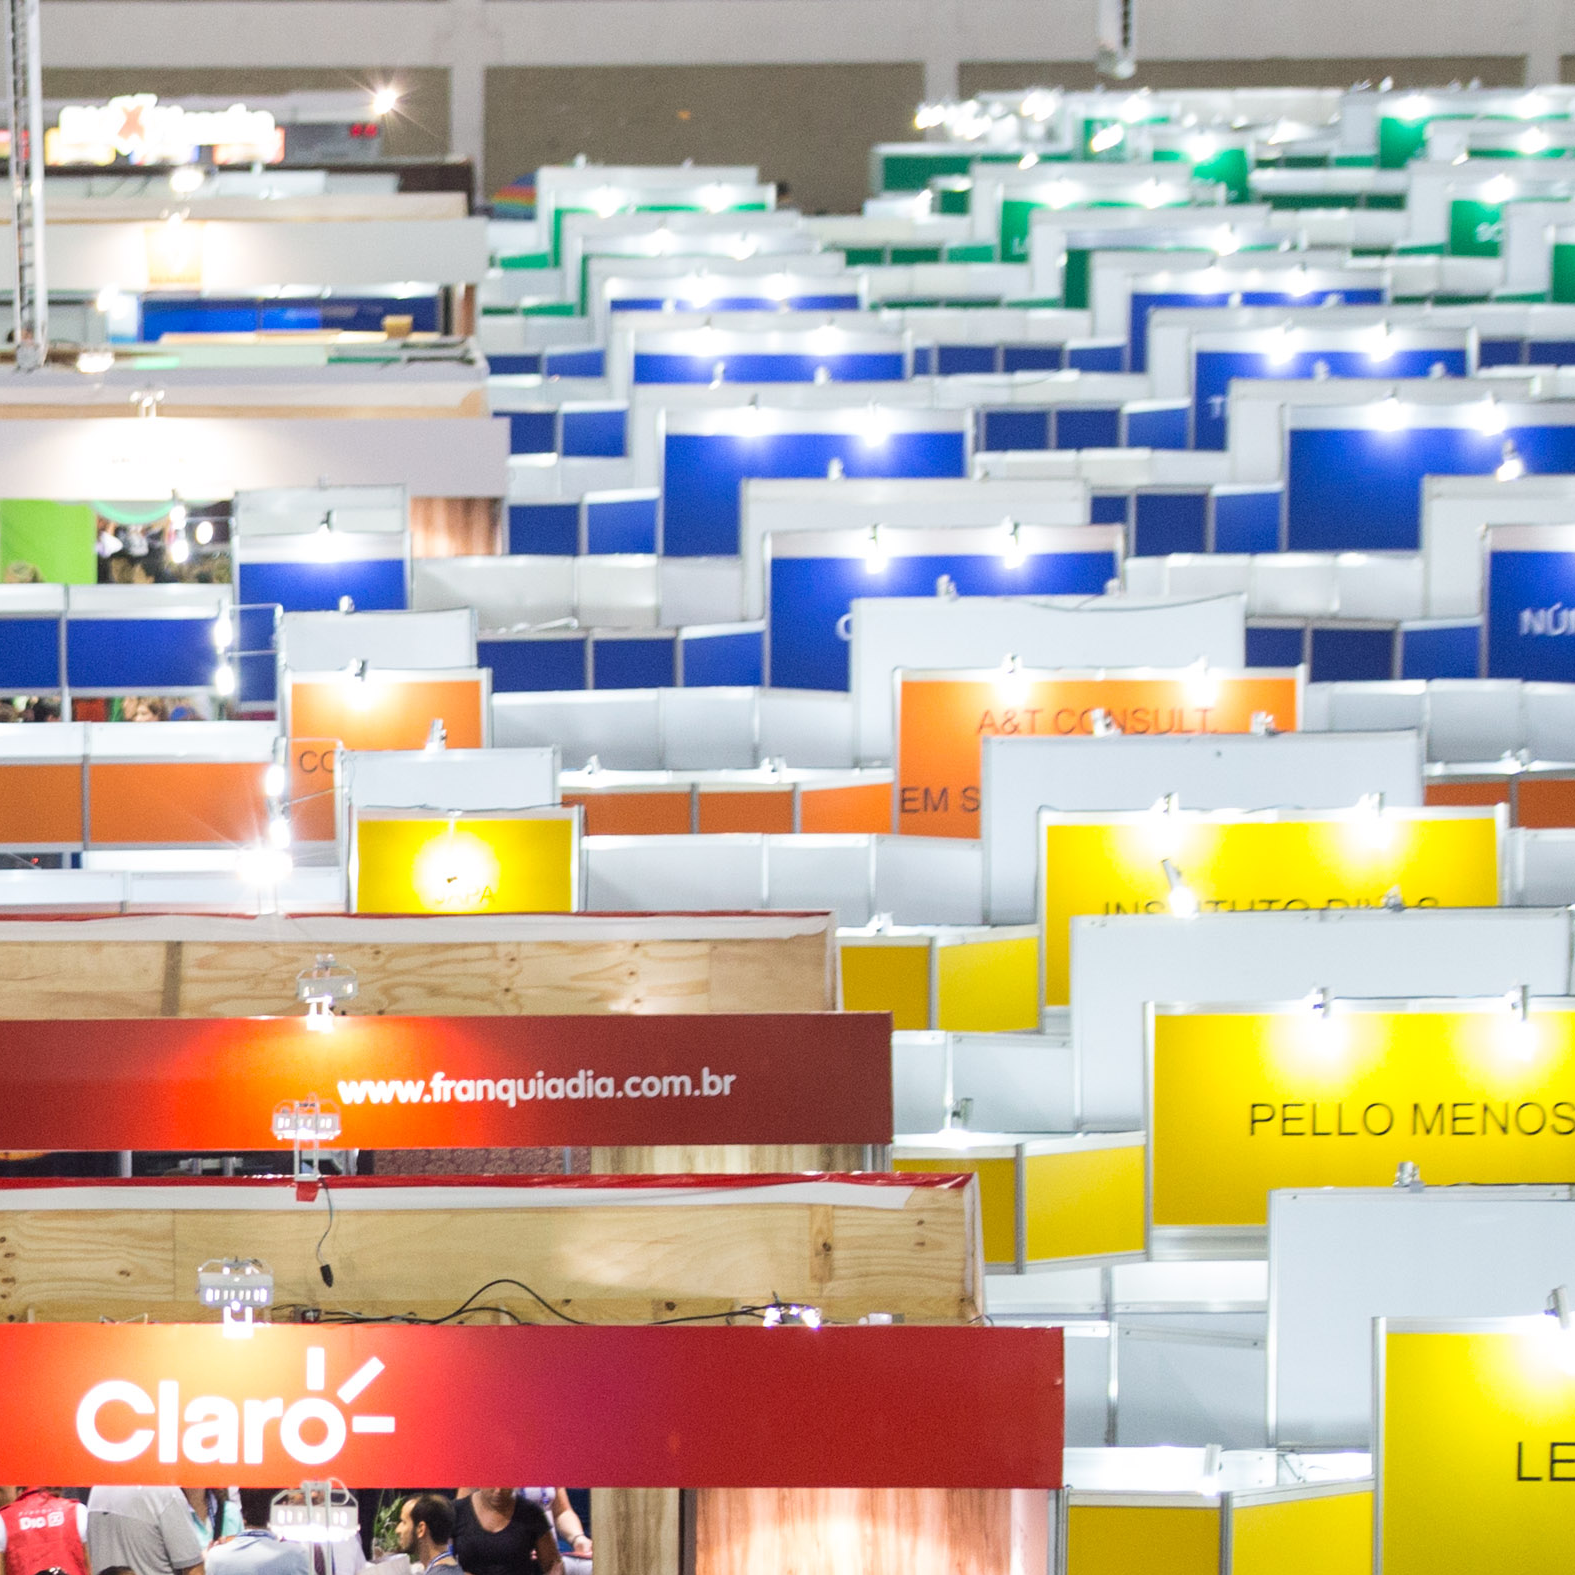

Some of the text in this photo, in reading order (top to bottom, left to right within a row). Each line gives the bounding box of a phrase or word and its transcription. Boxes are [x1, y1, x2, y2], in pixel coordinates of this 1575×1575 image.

[978, 708, 1043, 735] A&T
[337, 1067, 737, 1108] www.franquiadia.com.br
[1250, 1102, 1575, 1137] PELLO MENOS
[76, 1379, 347, 1465] Claro
